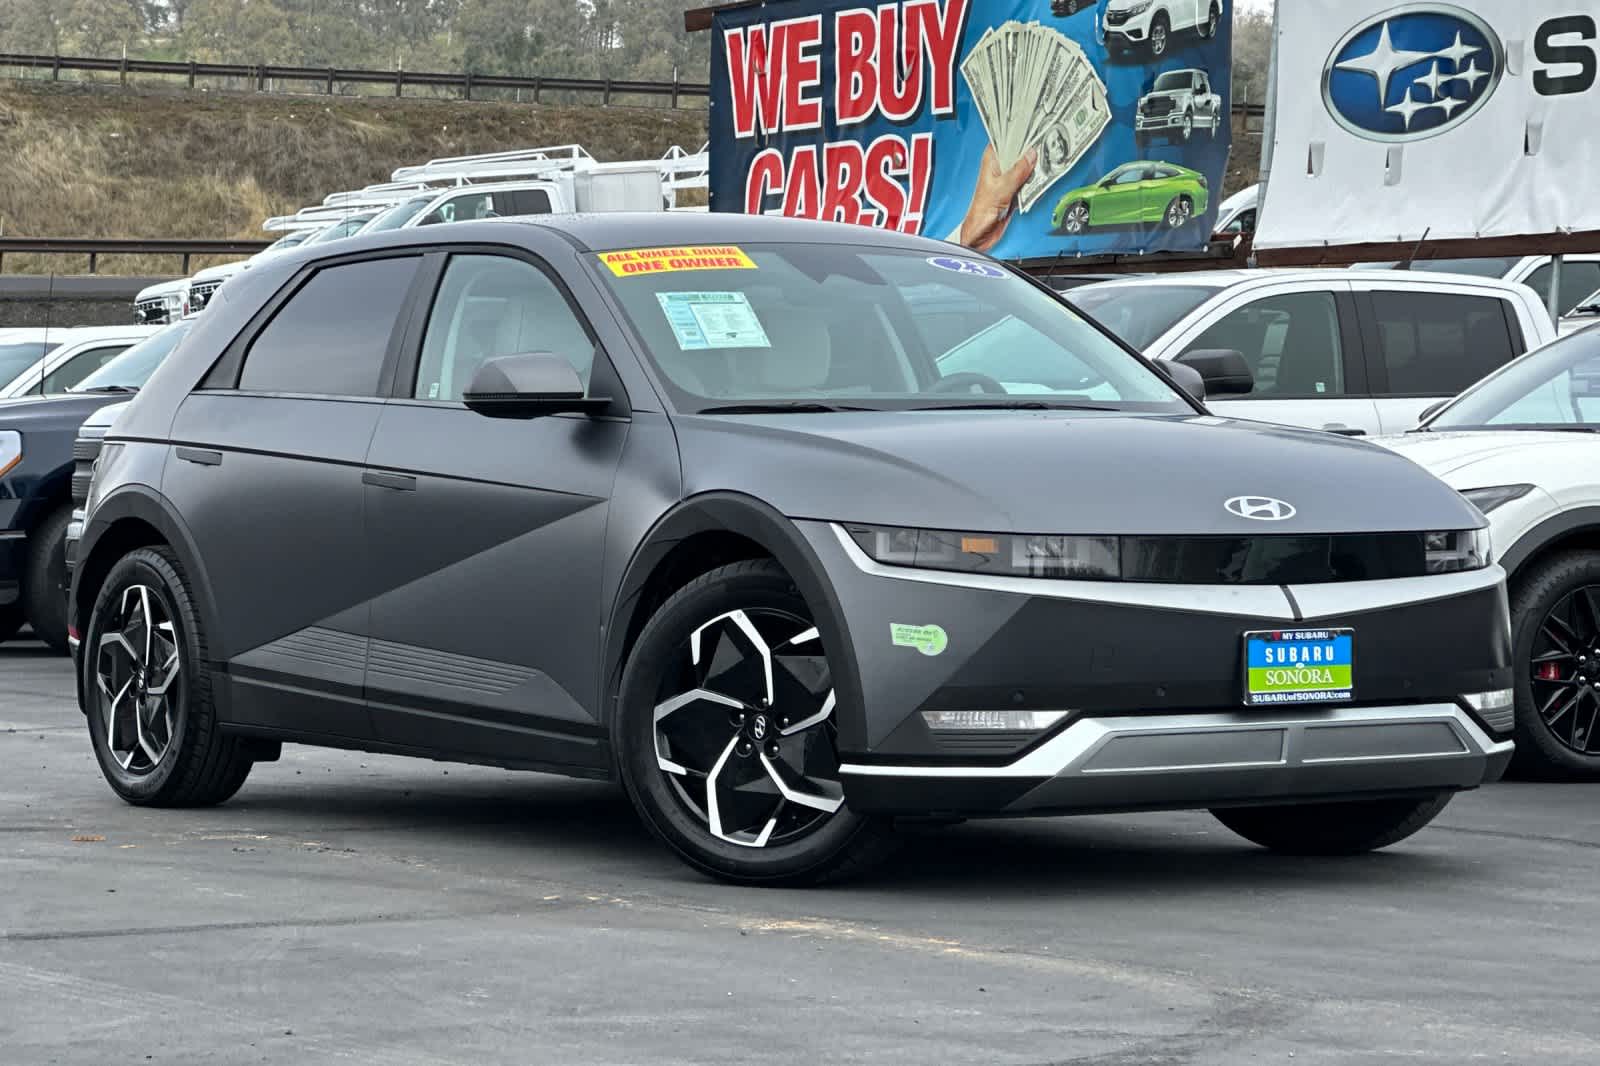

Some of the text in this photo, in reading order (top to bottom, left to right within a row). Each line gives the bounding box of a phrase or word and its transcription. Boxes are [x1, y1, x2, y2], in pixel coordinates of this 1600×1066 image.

[725, 0, 968, 138] WE BUY
[745, 132, 932, 233] CARS!
[606, 248, 737, 262] ALL WHEEL DRIVE
[622, 257, 744, 273] ONE OWNER
[1282, 631, 1329, 640] MY SUBARU
[1265, 645, 1334, 663] SUBARU
[1265, 669, 1334, 686] SONORA
